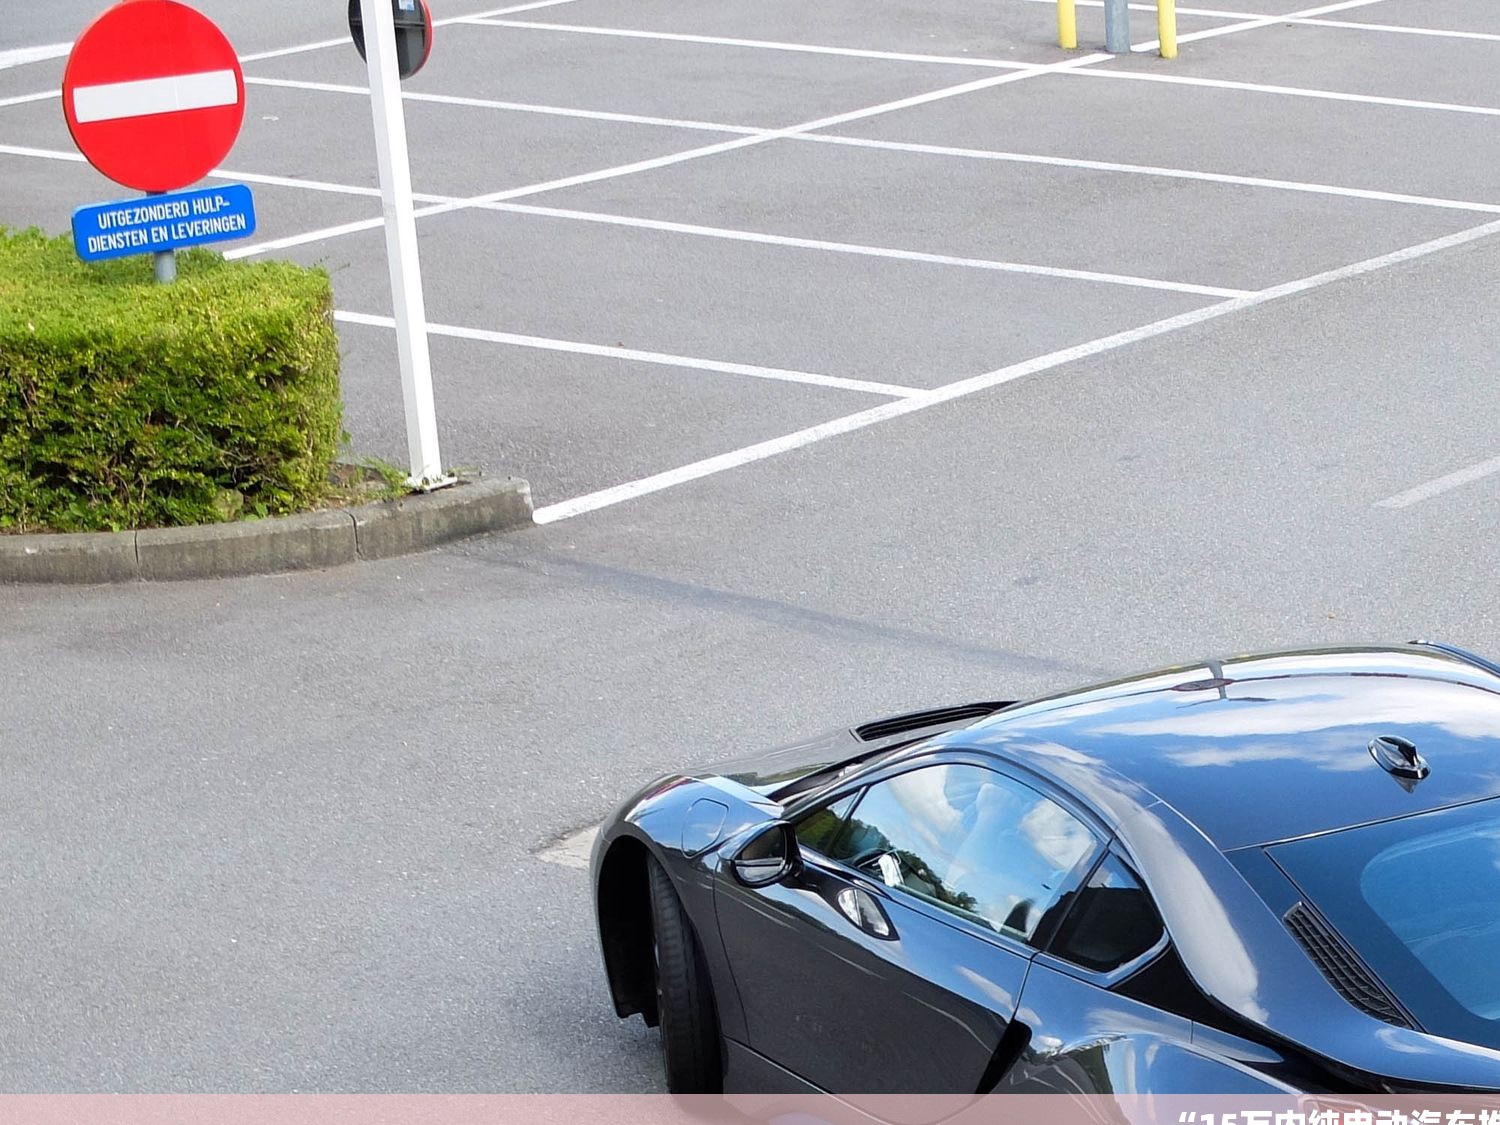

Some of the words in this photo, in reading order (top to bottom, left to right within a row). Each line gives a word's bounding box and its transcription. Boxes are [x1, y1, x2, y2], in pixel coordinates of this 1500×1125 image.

[97, 201, 189, 229] UITGEZONDERD
[193, 196, 230, 214] HULP-
[88, 229, 147, 253] DIENSTEN
[152, 226, 169, 243] EN
[171, 213, 247, 240] LEVERINGEN
